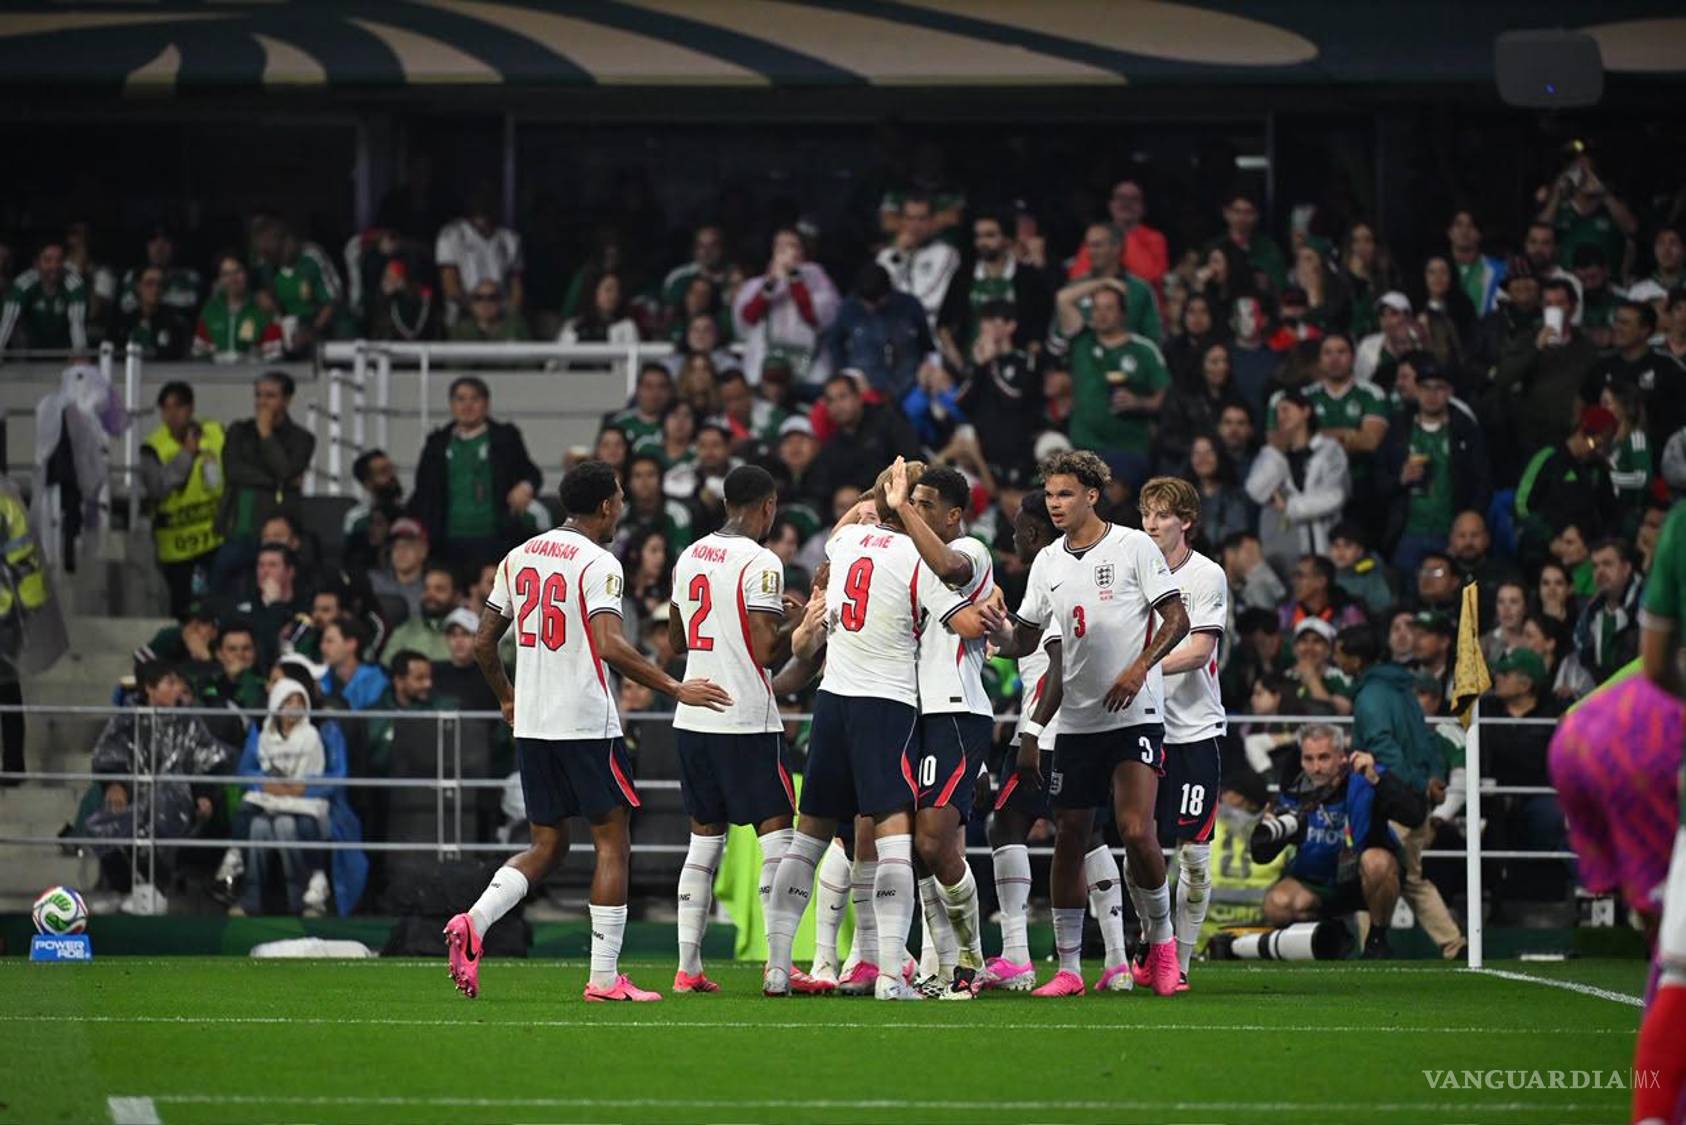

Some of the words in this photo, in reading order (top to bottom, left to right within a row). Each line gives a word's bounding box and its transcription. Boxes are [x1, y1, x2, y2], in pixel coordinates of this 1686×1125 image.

[691, 544, 727, 563] KONSA
[515, 567, 567, 652] 26
[840, 557, 874, 632] 9
[688, 574, 714, 651] 2
[1073, 605, 1086, 638] 3
[1139, 736, 1154, 764] 3
[1180, 783, 1205, 816] 18
[788, 886, 808, 898] ENG
[876, 889, 896, 898] ENG
[35, 941, 85, 951] POWER
